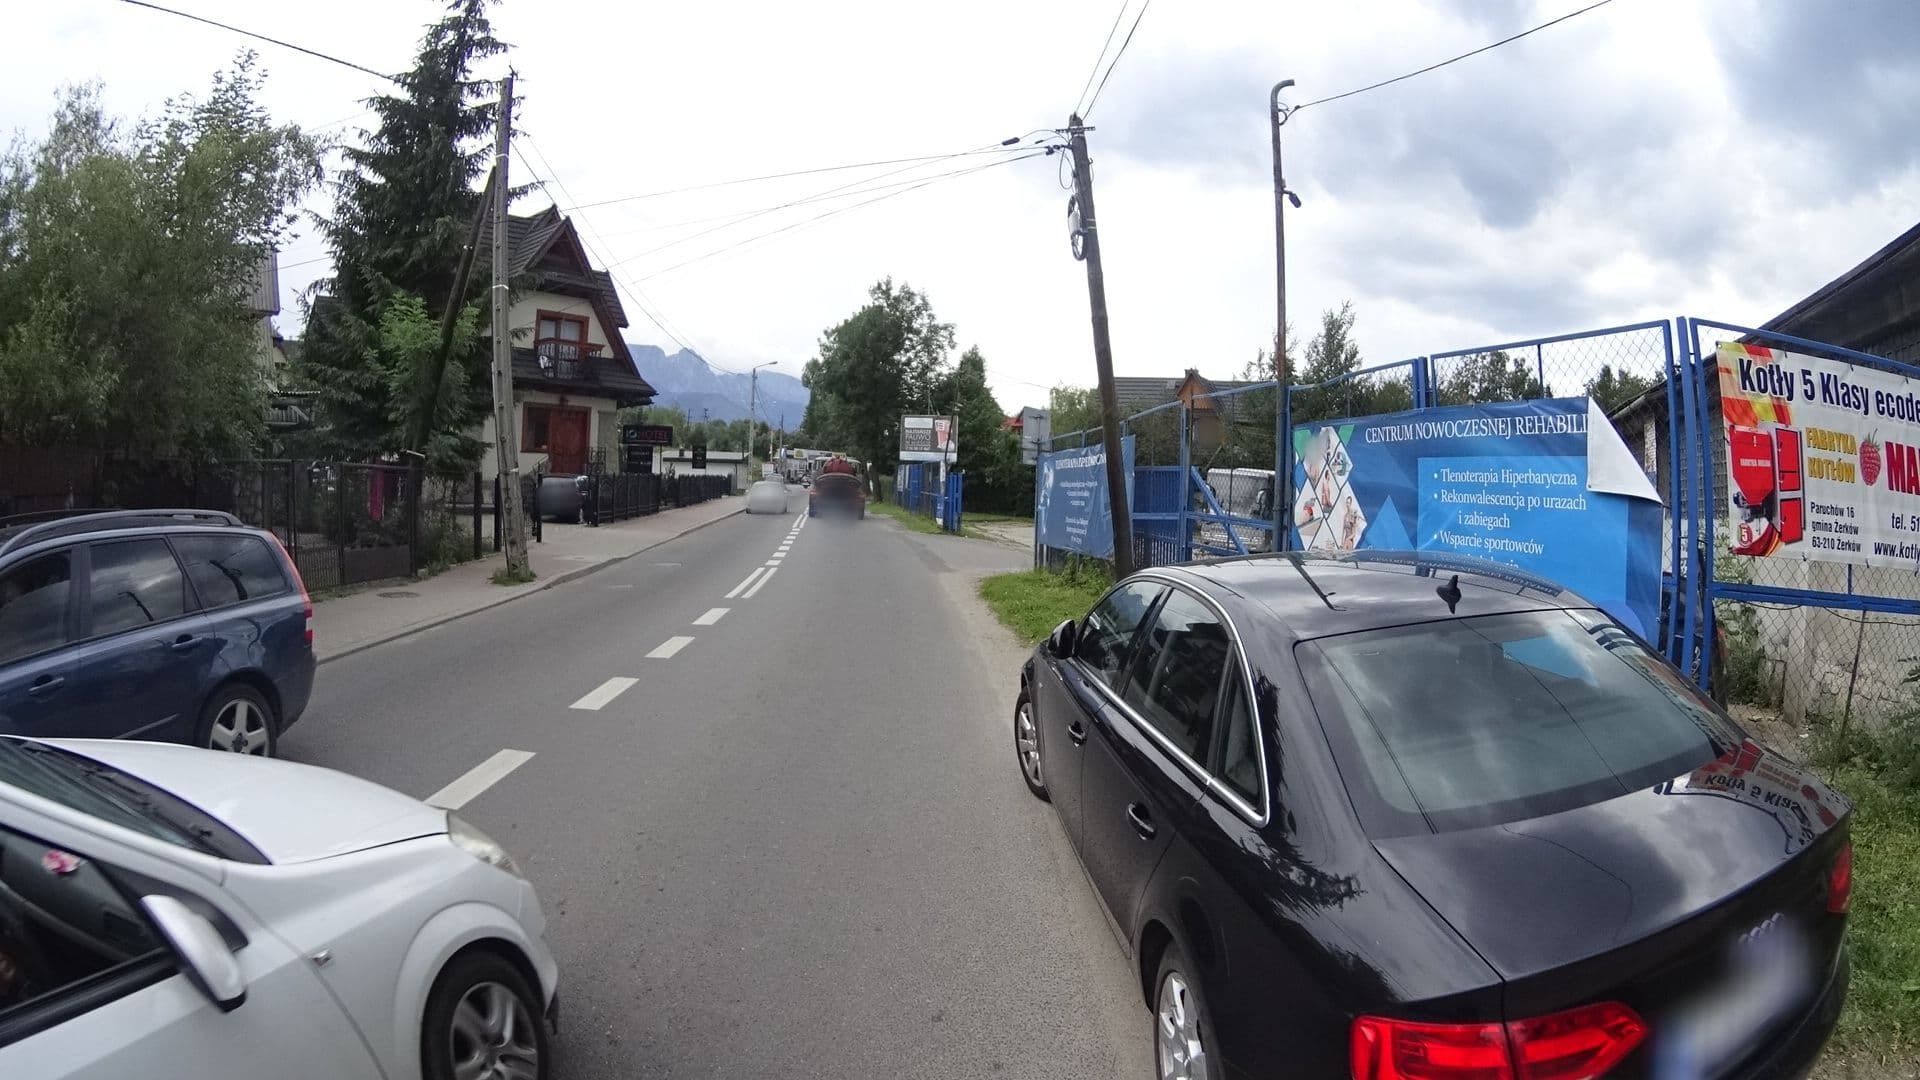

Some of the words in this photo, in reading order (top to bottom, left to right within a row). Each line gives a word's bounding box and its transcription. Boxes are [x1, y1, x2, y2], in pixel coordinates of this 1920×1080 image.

[1738, 358, 1795, 403] Kotły
[1801, 368, 1816, 401] 5
[1820, 372, 1870, 416] Klasy
[1365, 423, 1414, 444] CENTRUM
[1415, 416, 1512, 441] NOWOCZESNEJ
[1806, 427, 1858, 456] FABRYKA
[1441, 468, 1499, 486] Tlenoterapia
[1501, 469, 1578, 488] Hiperbaryczna
[1808, 456, 1857, 484] KOTŁÓW
[1885, 441, 1920, 496] MA
[1441, 489, 1525, 511] Rekonwalescencja
[1528, 496, 1541, 511] po
[1543, 494, 1587, 511] urazach
[1810, 501, 1844, 517] Paruchów
[1846, 507, 1855, 518] 16
[1458, 511, 1463, 525] i
[1464, 511, 1511, 531] zabiegach
[1812, 520, 1833, 533] gmina
[1834, 518, 1859, 536] Żerków
[1891, 513, 1907, 530] tel.
[1440, 530, 1482, 549] Wsparcie
[1484, 537, 1544, 555] sportowców
[1812, 536, 1835, 550] 63-210
[1836, 536, 1861, 552] Żerków
